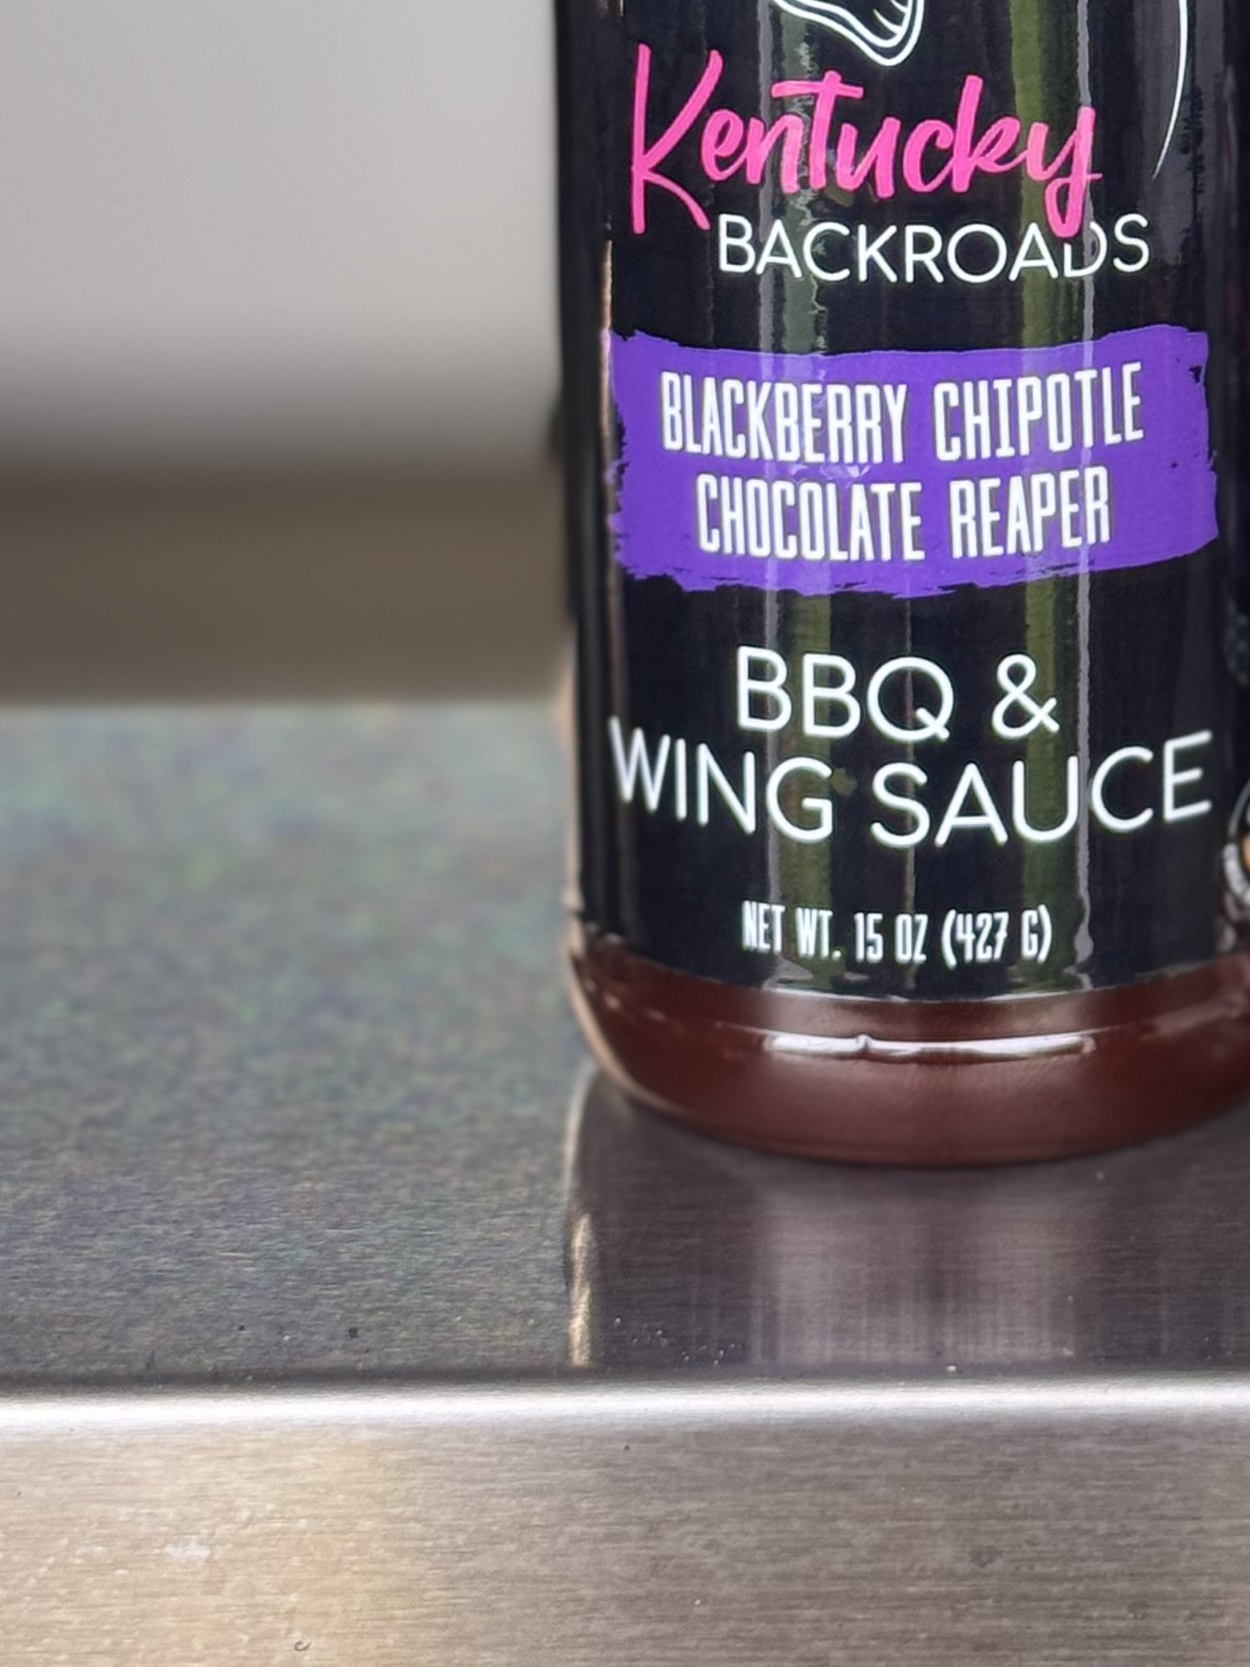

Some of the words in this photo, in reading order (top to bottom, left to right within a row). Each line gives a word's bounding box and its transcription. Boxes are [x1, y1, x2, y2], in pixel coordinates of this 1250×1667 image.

[630, 42, 1101, 239] Kentucky
[717, 212, 1150, 284] BACKROADS
[660, 370, 908, 465] BLACKBERRY
[932, 361, 1145, 462] CHIPOTLE
[696, 472, 926, 563] CHOCOLATE
[948, 465, 1111, 560] REAPER
[736, 645, 955, 743] BBQ
[991, 653, 1061, 739] &
[608, 716, 835, 843] WING
[869, 730, 1213, 848] SAUCE
[742, 899, 786, 954] NET
[794, 906, 842, 960] WT.
[853, 911, 883, 962] 15
[895, 913, 929, 963] OZ
[941, 909, 1010, 968] (427
[1021, 903, 1053, 963] G)
